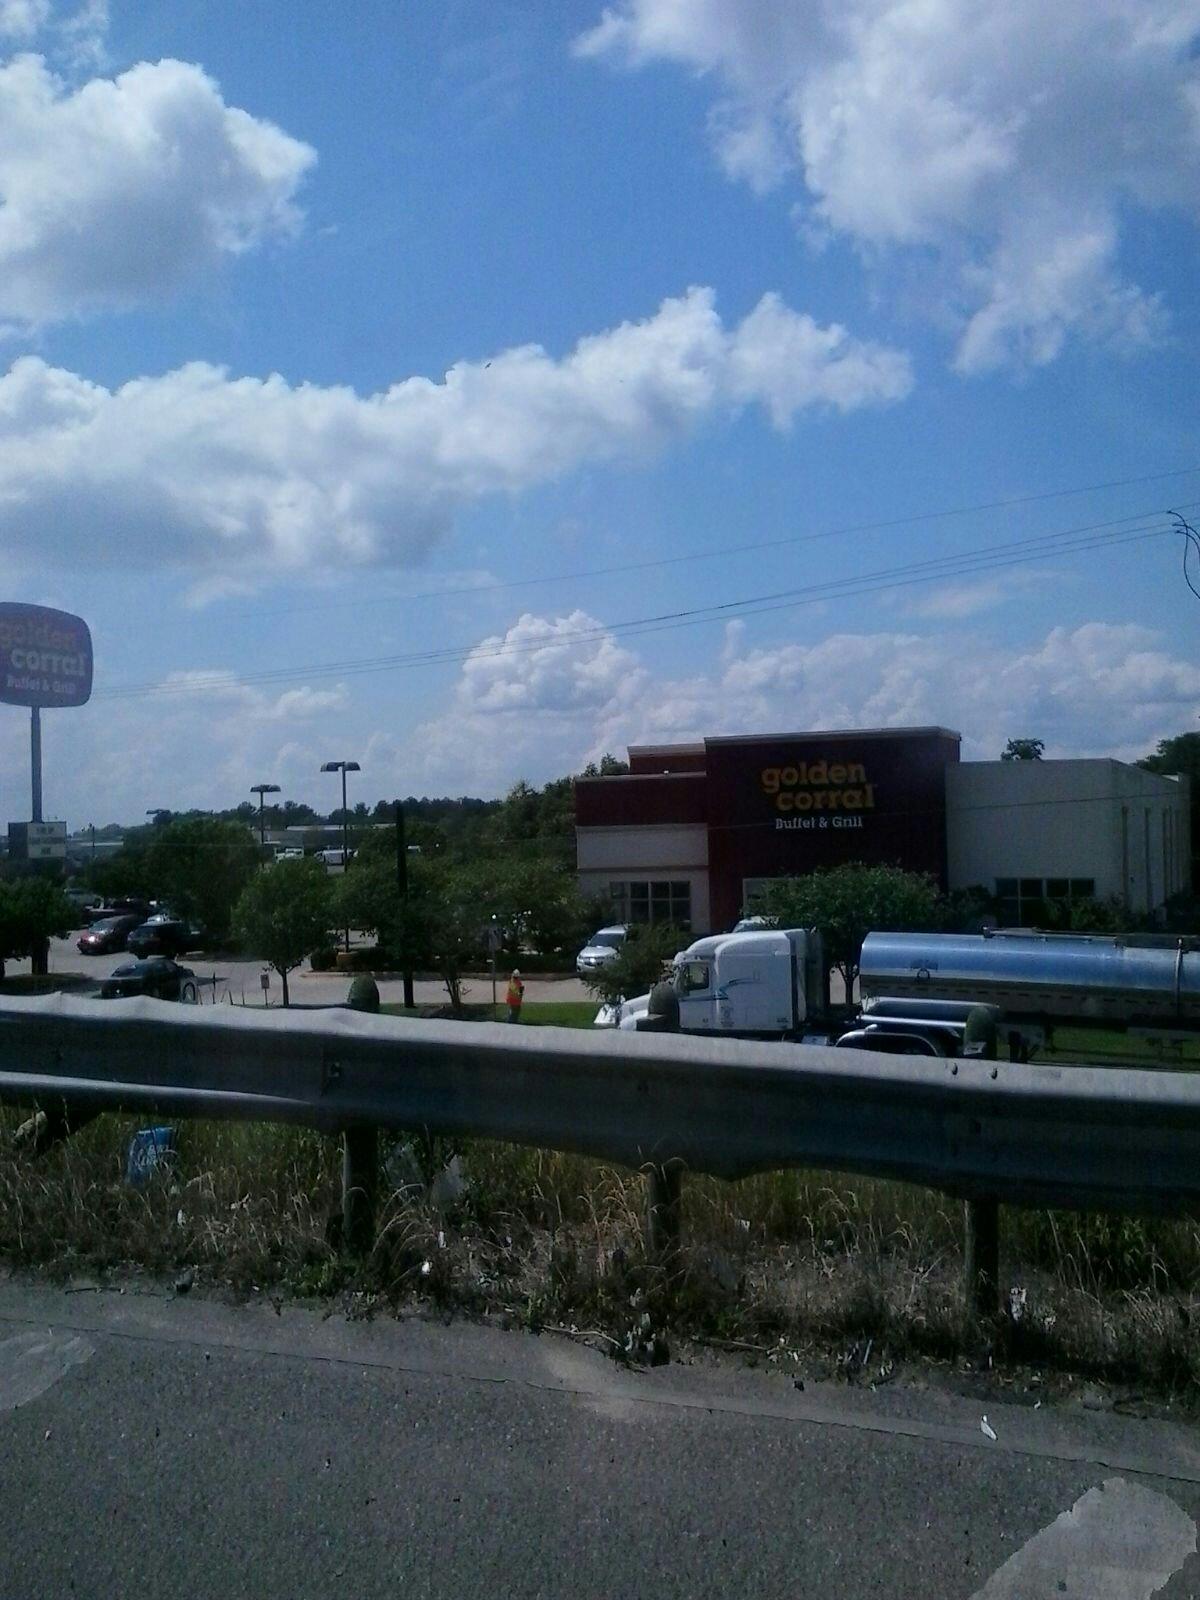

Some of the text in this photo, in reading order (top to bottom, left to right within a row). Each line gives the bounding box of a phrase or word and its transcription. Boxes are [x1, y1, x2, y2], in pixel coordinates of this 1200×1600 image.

[11, 647, 86, 677] corral
[761, 760, 866, 794] golden
[776, 784, 874, 811] corral
[775, 816, 864, 830] Buffet & Grill
